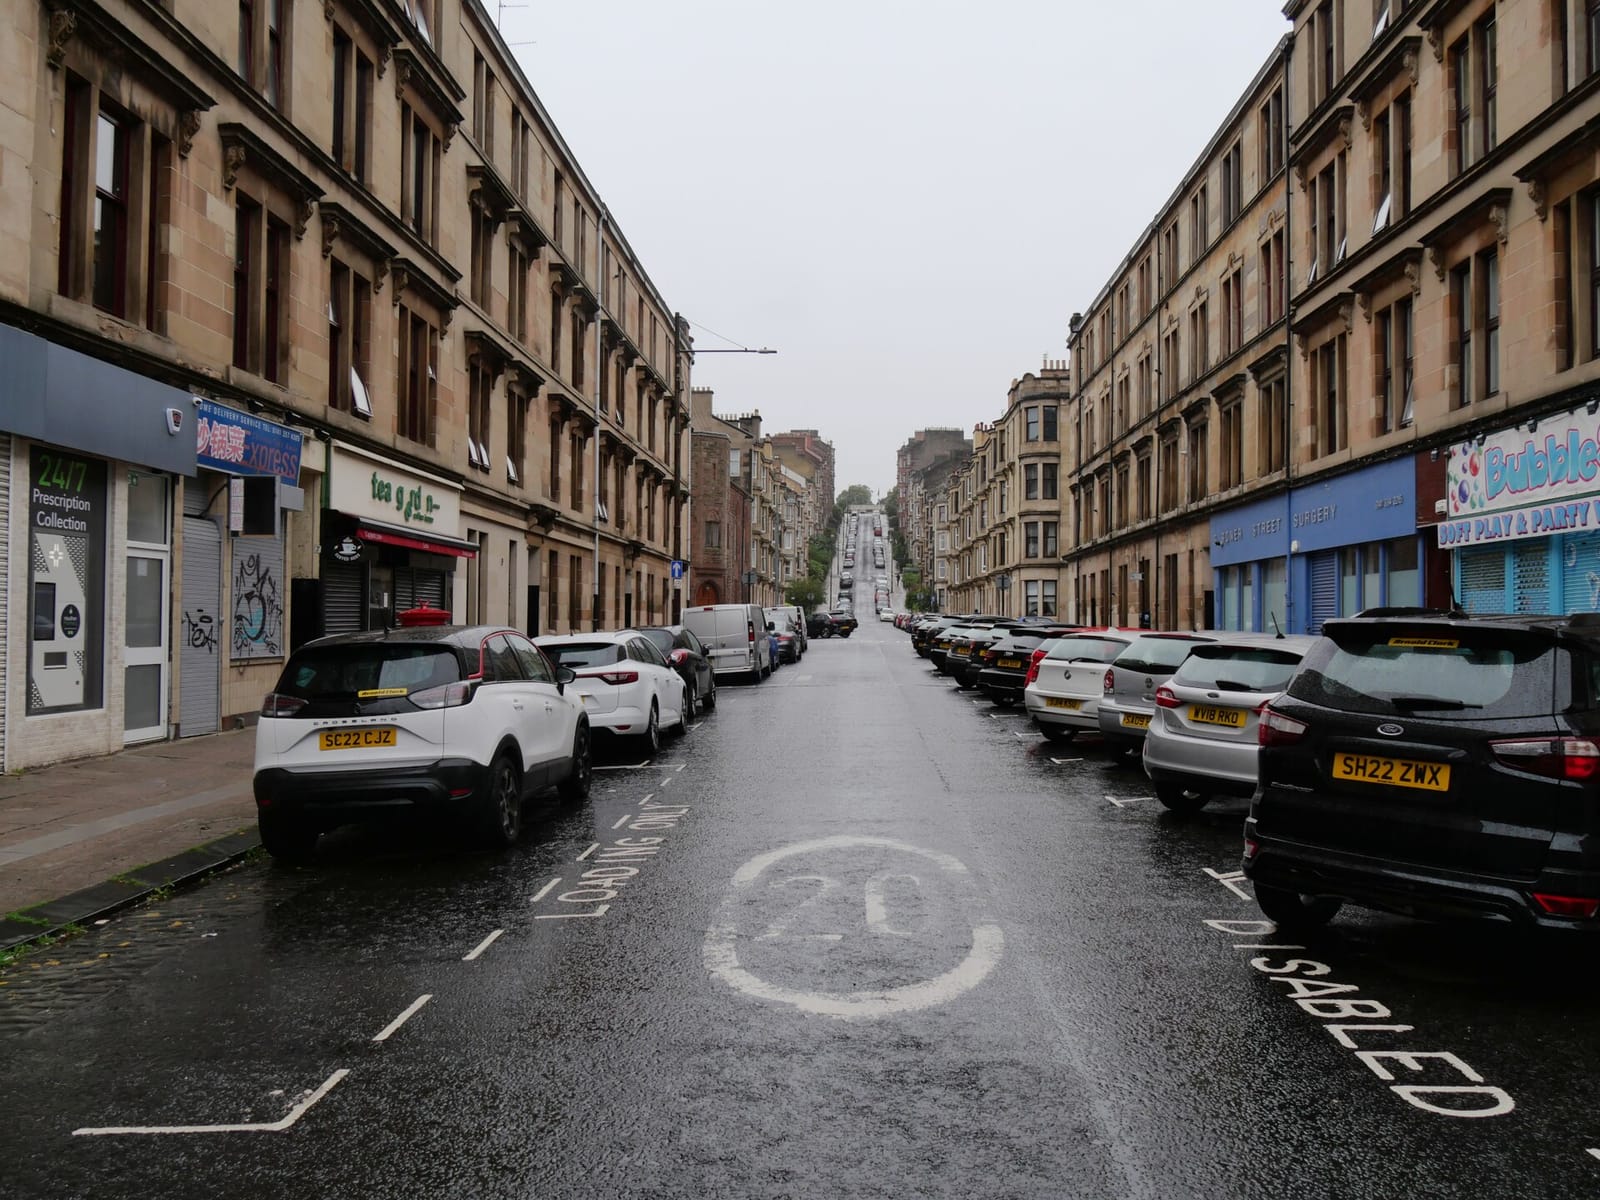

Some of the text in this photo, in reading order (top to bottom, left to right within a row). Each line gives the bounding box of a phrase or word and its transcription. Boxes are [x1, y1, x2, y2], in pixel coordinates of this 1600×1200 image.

[214, 406, 239, 421] DELIVERY
[38, 454, 87, 492] 24/7
[1485, 427, 1600, 501] Bubble
[33, 488, 91, 512] Prescription
[371, 471, 392, 503] tea
[36, 511, 87, 532] Collection
[1252, 518, 1282, 538] STREET
[1292, 503, 1338, 529] SURGERY
[1439, 521, 1471, 546] SOFT
[1474, 514, 1513, 541] PLAY
[1516, 511, 1529, 535] &
[1531, 501, 1590, 533] PARTY
[364, 729, 391, 745] CJZ
[1342, 756, 1441, 787] SH22 ZWX
[628, 802, 691, 830] ONLY
[535, 837, 666, 919] LOADING
[1203, 918, 1516, 1118] DISABLED
